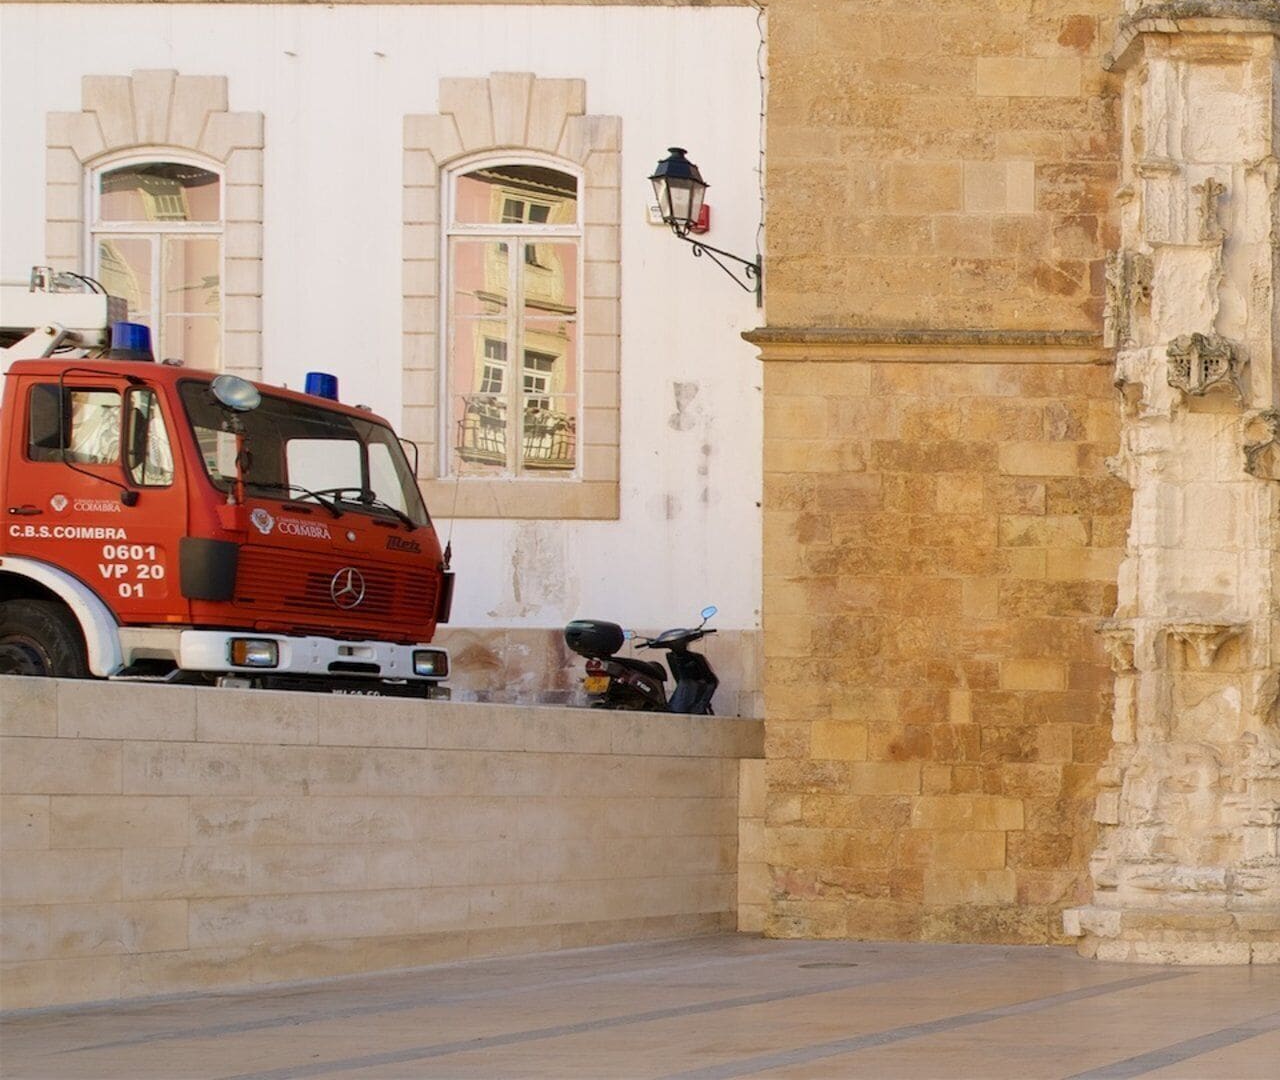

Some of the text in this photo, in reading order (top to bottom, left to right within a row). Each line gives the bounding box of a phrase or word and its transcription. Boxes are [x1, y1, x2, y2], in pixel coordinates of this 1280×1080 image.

[73, 502, 121, 513] COIMBRA
[278, 522, 332, 540] COIMBRA
[102, 544, 156, 561] 0601
[98, 563, 165, 579] VP 20
[118, 582, 144, 598] 01
